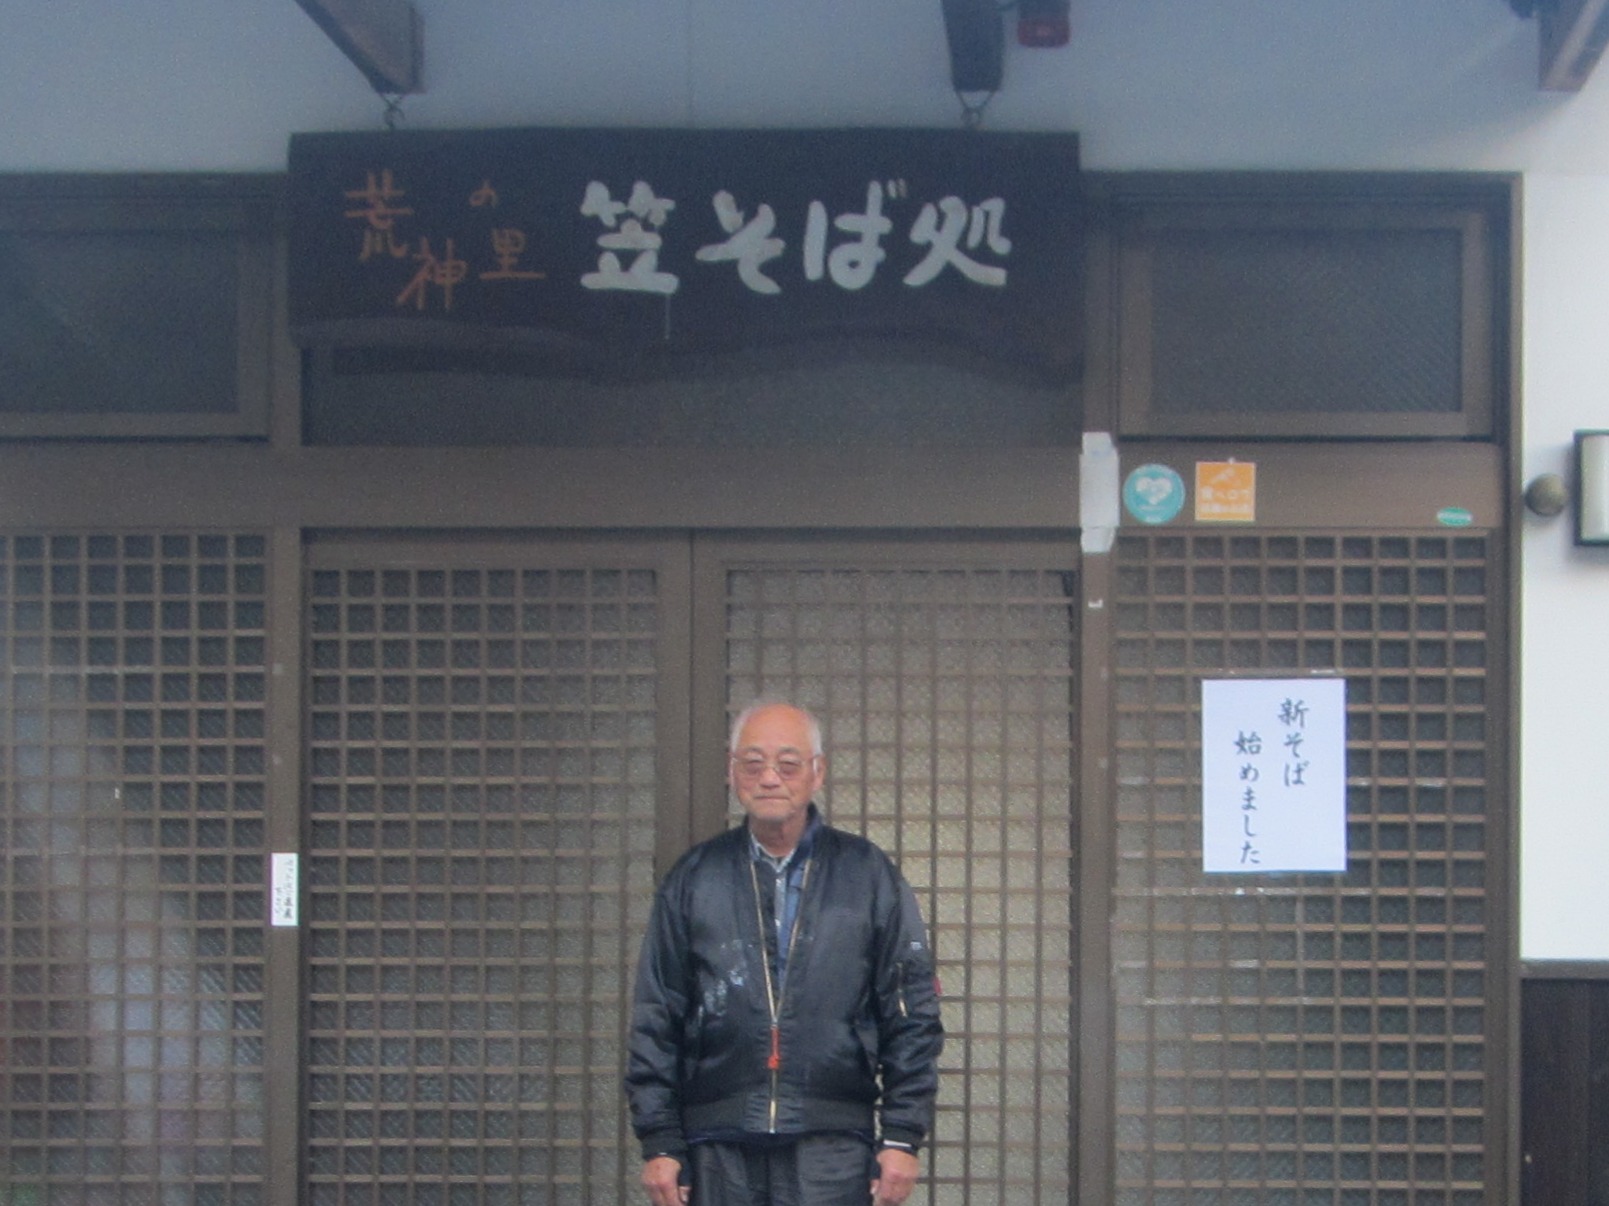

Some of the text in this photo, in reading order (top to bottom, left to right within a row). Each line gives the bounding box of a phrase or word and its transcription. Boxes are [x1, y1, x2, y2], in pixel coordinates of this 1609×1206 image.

[580, 179, 1012, 295] 笠そば処
[1233, 730, 1263, 865] 始めました
[1277, 697, 1310, 787] 新そば
